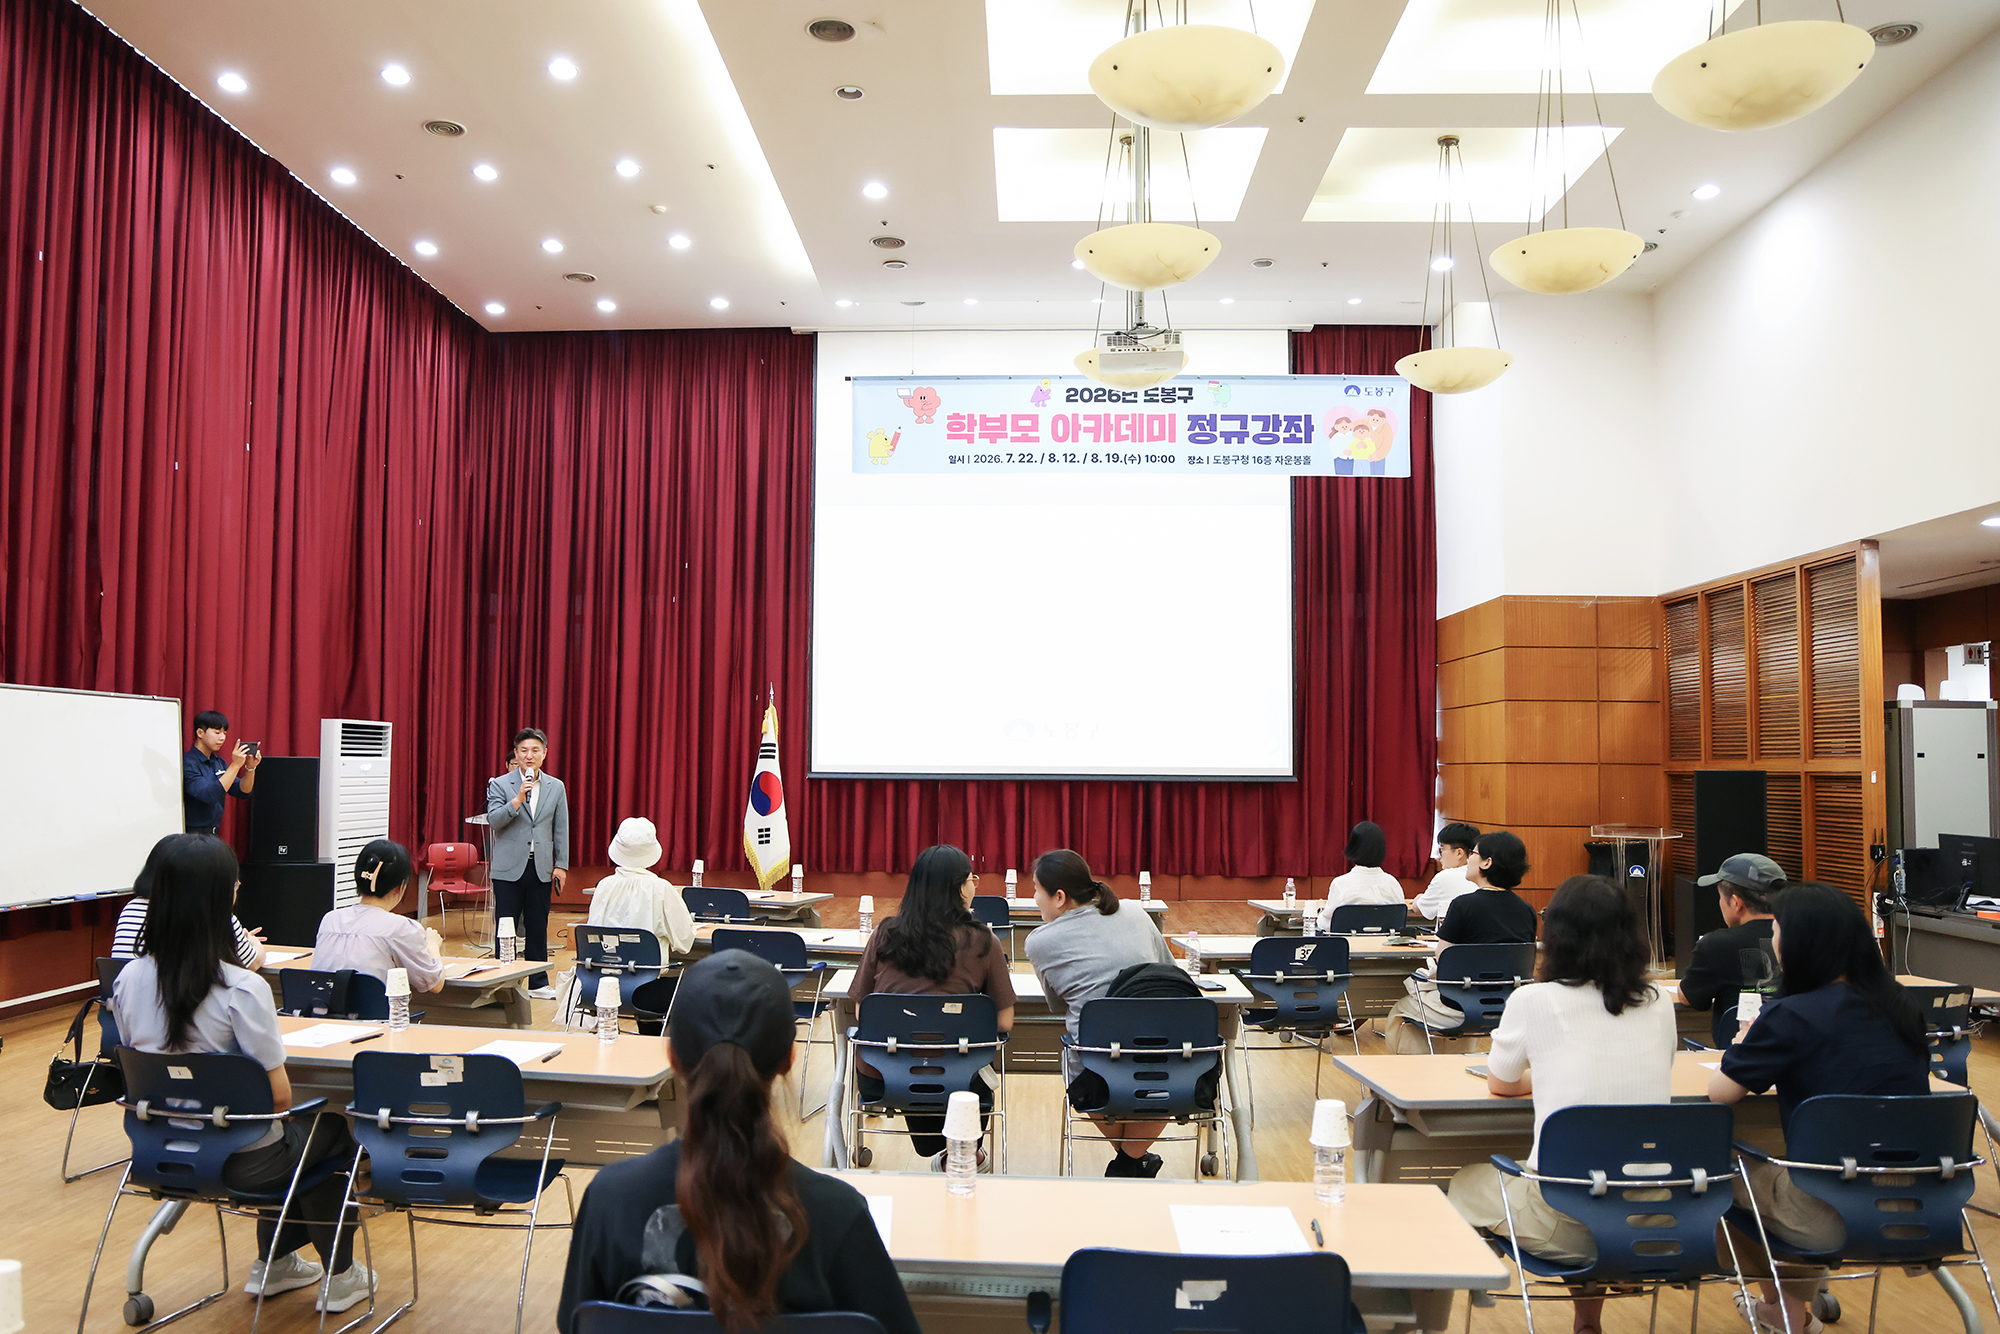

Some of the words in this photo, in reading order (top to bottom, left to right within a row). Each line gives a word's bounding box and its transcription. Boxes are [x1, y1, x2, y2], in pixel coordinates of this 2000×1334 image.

[1143, 387, 1194, 404] 도봉구
[1364, 386, 1395, 397] 도봉구
[946, 412, 1041, 444] 학부모
[1051, 412, 1177, 443] 아카데미
[1187, 413, 1315, 445] 정규강좌
[948, 454, 965, 465] 일시
[973, 454, 1003, 464] 2026.
[1005, 452, 1015, 464] 7.
[1018, 452, 1038, 464] 22.
[1048, 452, 1060, 464] 8.
[1062, 452, 1080, 464] 12.
[1090, 452, 1102, 464] 8.
[1105, 452, 1142, 465] 19.(수)
[1144, 454, 1176, 464] 10:00
[1187, 455, 1204, 465] 장소
[1212, 455, 1250, 466] 도봉구청
[1251, 455, 1273, 466] 16층
[1274, 455, 1312, 466] 자운봉홀
